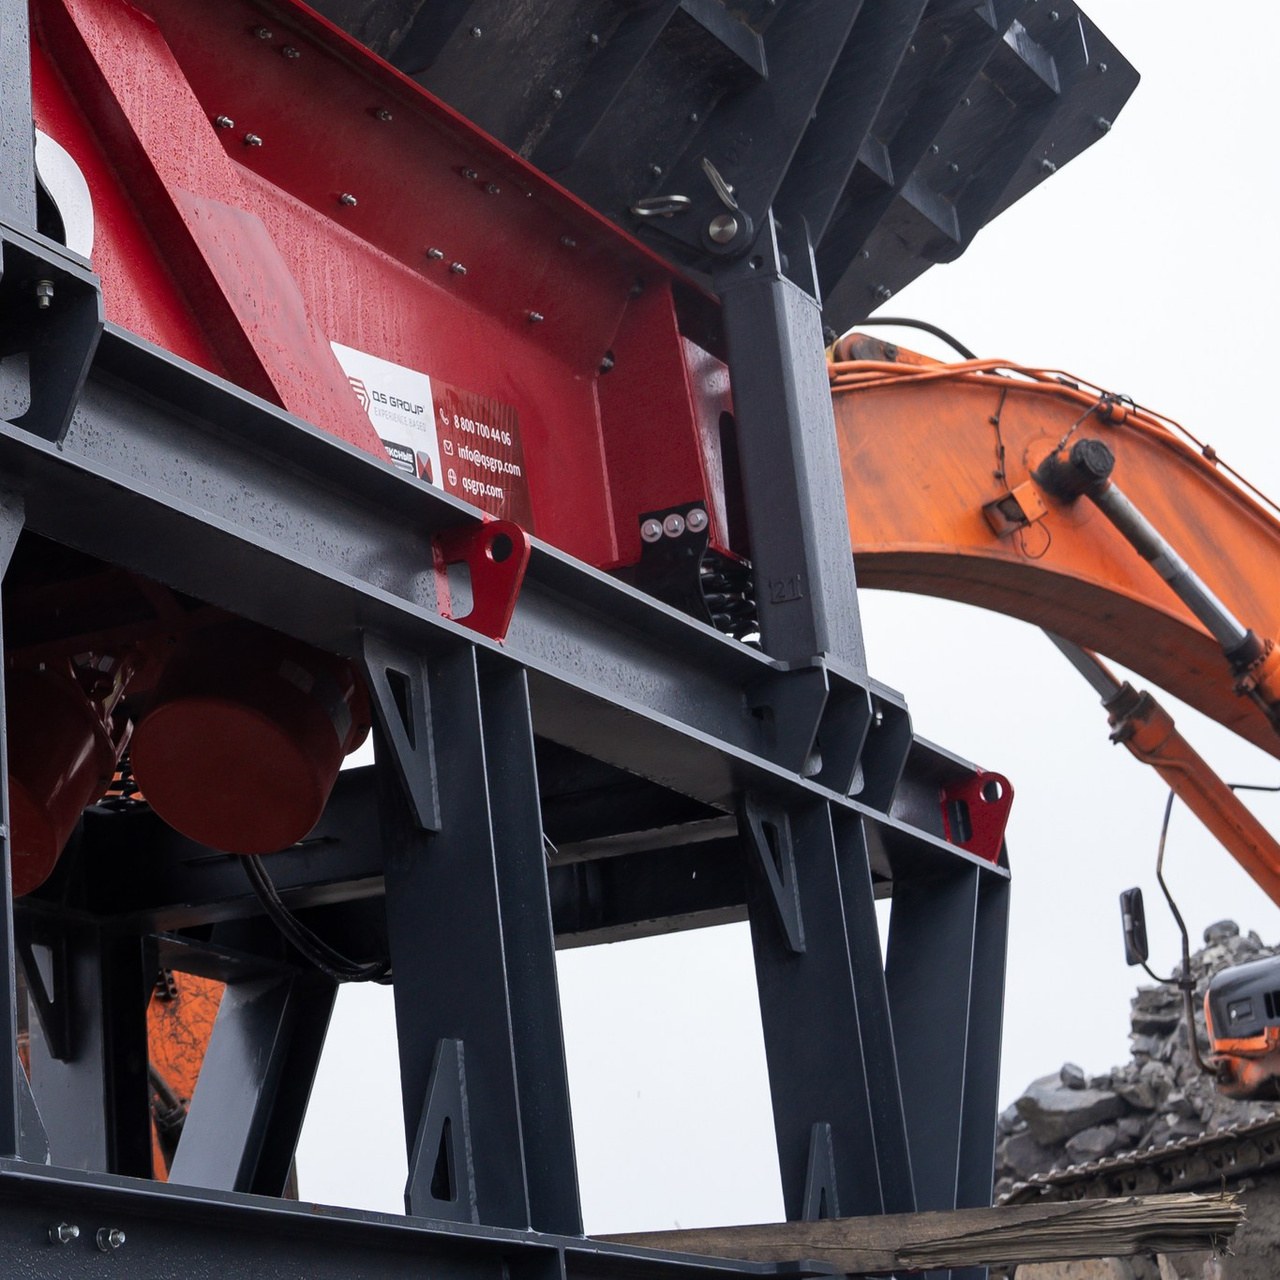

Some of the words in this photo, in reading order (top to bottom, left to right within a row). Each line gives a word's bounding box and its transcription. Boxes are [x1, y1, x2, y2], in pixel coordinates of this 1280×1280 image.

[372, 390, 388, 405] QS
[389, 396, 424, 415] GROUP
[454, 414, 460, 429] 8
[460, 417, 475, 434] 800
[475, 422, 490, 439] 700
[491, 427, 501, 443] 44
[501, 431, 512, 446] 06
[457, 443, 521, 477] info@qsgrp.com
[462, 477, 504, 498] qsgrp.com
